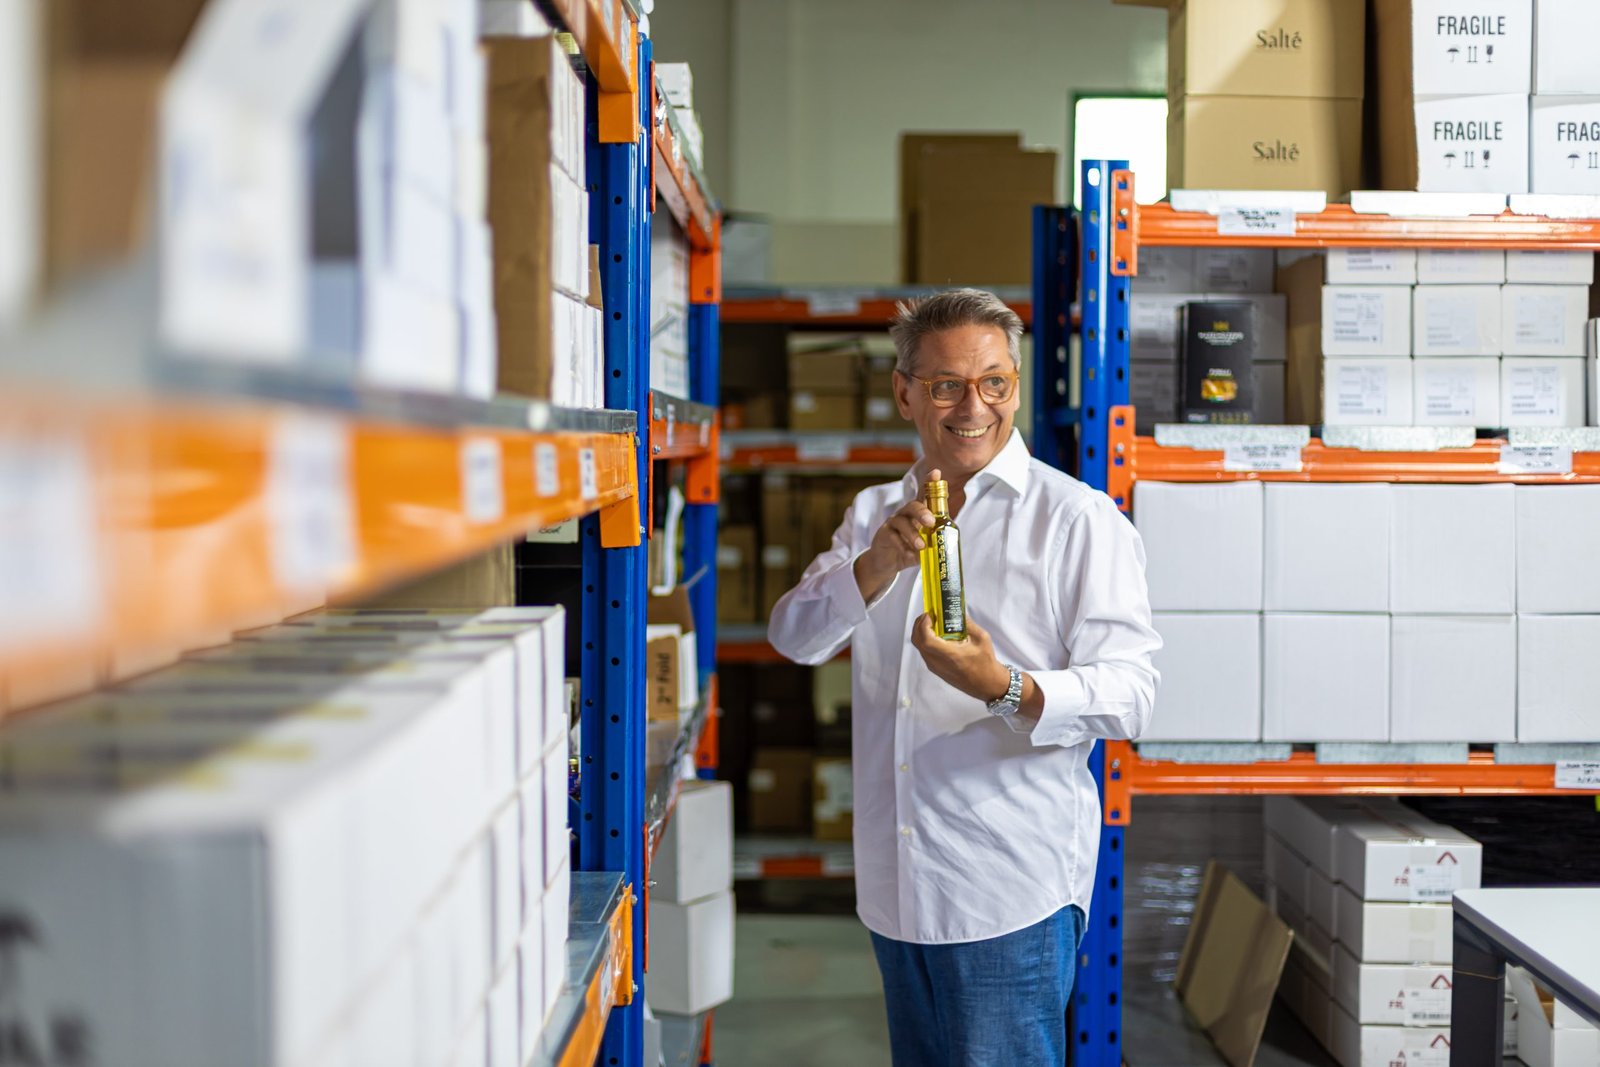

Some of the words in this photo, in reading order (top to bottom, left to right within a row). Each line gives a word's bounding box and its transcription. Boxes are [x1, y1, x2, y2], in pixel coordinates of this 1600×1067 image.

[1437, 15, 1506, 36] FRAGILE
[1256, 27, 1303, 49] Salté
[1433, 121, 1503, 141] FRAGILE
[1252, 138, 1300, 161] Salté
